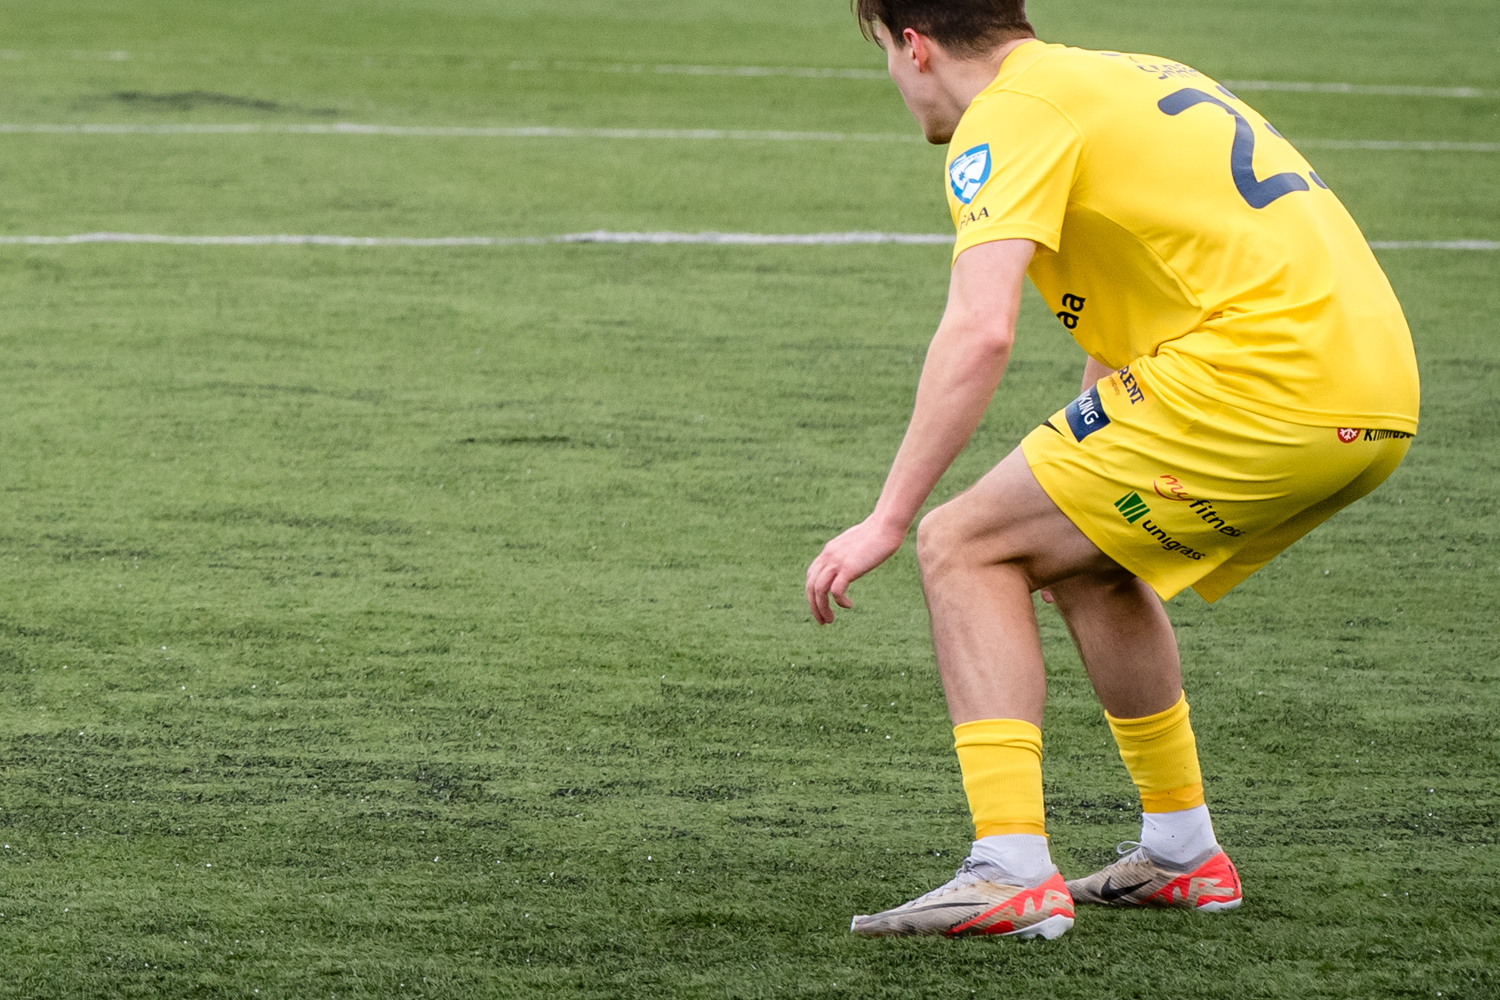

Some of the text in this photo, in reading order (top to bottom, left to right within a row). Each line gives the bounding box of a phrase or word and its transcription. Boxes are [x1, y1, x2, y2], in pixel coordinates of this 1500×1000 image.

[1157, 87, 1322, 209] 2
[1118, 365, 1145, 405] RENT
[1141, 519, 1206, 560] unigrass
